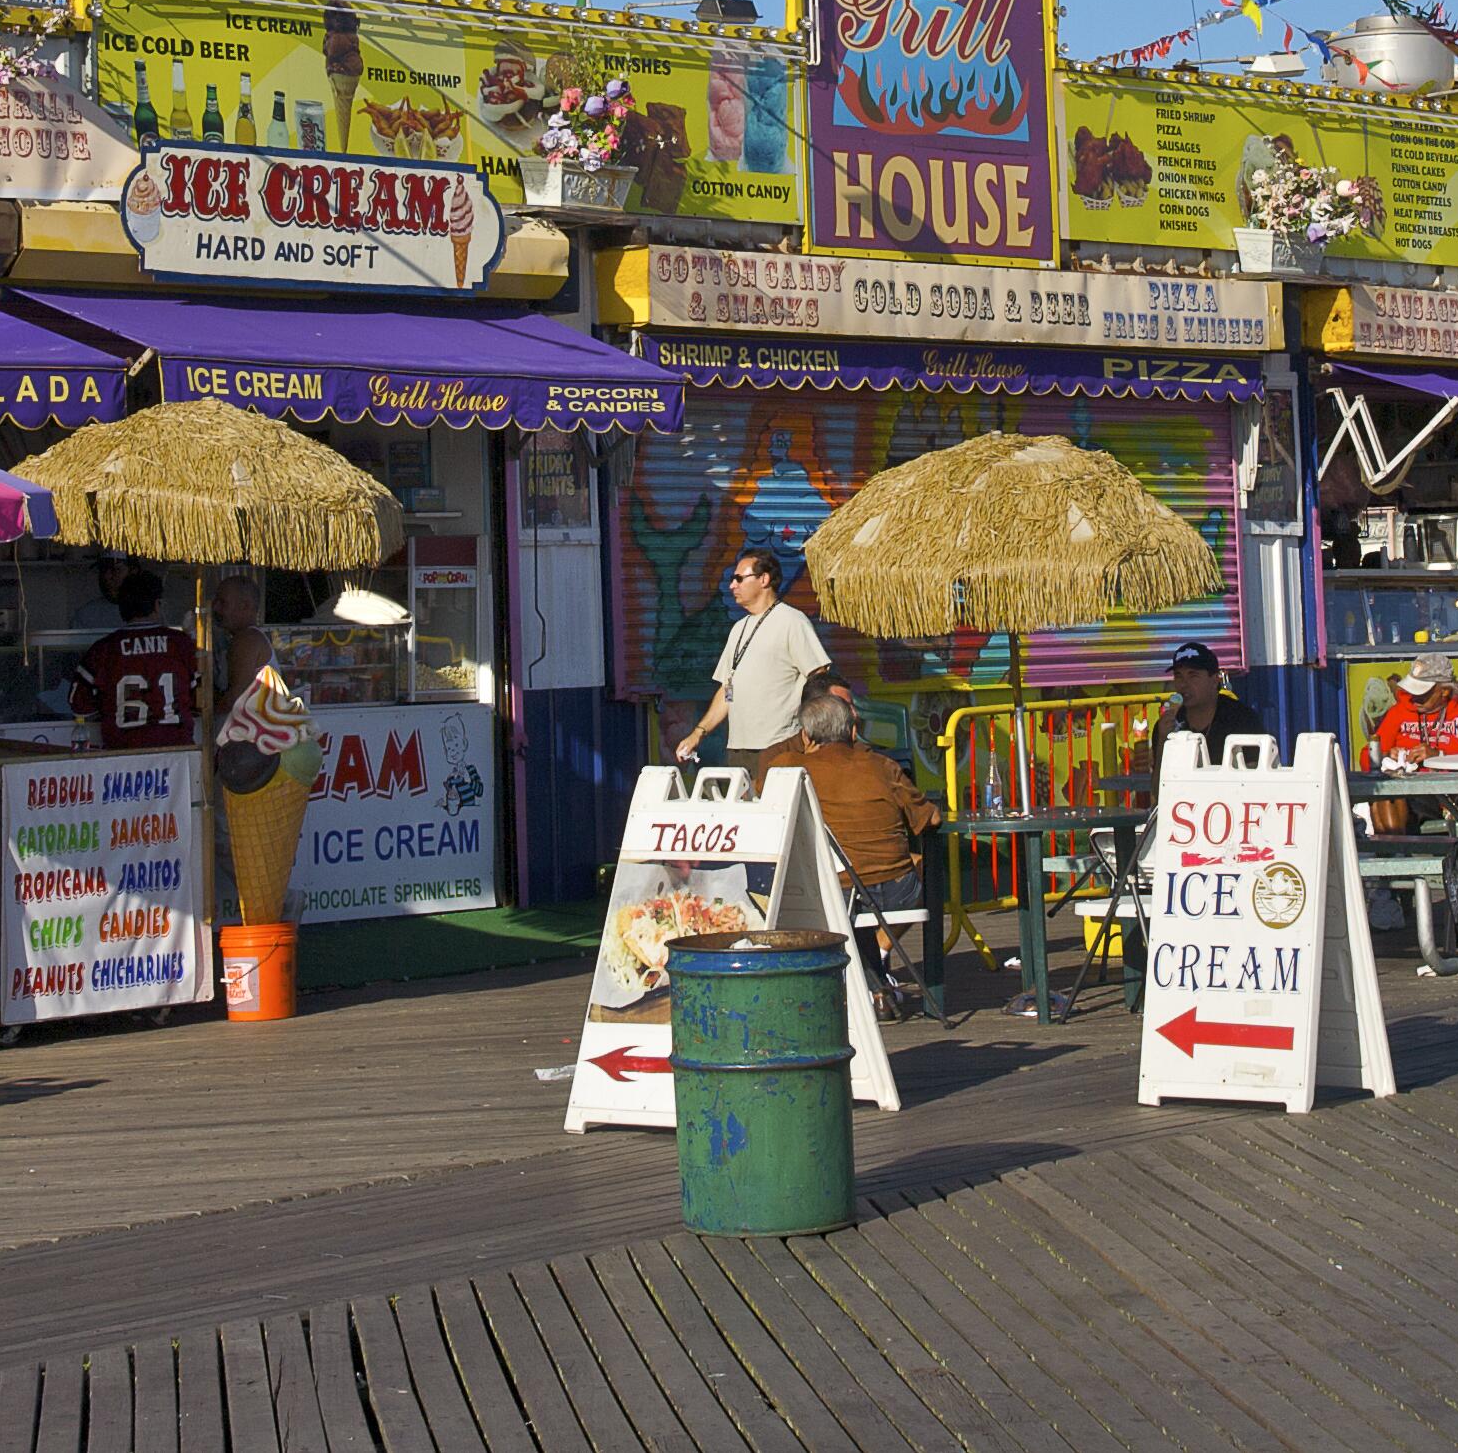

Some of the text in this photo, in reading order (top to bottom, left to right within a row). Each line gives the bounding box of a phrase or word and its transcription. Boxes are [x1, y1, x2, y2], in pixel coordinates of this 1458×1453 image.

[226, 13, 313, 37] ICE CREAM
[103, 32, 251, 62] ICE COLD BEER
[366, 66, 462, 89] FRIED SHRIMP
[1156, 109, 1215, 123] FRIED SHRIMP
[1156, 124, 1182, 136] PIZZA
[1157, 140, 1201, 153] SAUSAGES
[1391, 148, 1403, 158] ICE
[1404, 149, 1424, 160] COLD
[1157, 156, 1217, 171] FRENCH FRIES
[691, 177, 792, 205] COTTON CANDY
[1158, 172, 1214, 186] ONION RINGS
[161, 153, 451, 237] ICE CREAM
[832, 150, 1037, 248] HOUSE
[1159, 188, 1225, 203] CHICKEN WINGS
[1159, 205, 1210, 217] CORN DOGS
[1160, 220, 1198, 232] KNISHES
[196, 233, 379, 269] HARD AND SOFT
[853, 278, 1091, 327] COLD SODA & BEER
[659, 342, 839, 372] SHRIMP & CHICKEN
[1102, 357, 1248, 385] PIZZA
[186, 366, 322, 399] ICE CREAM
[368, 373, 509, 412] Grill House
[547, 386, 660, 403] POPCORN
[545, 398, 666, 415] & CANDIES
[120, 635, 168, 656] CANN
[115, 673, 180, 730] 61
[28, 767, 169, 810] REDBULL SNAPPLE
[17, 813, 179, 861] GATORADE SANGRIA
[650, 823, 740, 852] TACOS
[1167, 801, 1310, 848] SOFT
[314, 819, 480, 865] ICE CREAM
[14, 858, 181, 905] TROPICANA JARITOS
[393, 878, 482, 904] SPRINKLERS
[1163, 871, 1244, 920] ICE
[30, 906, 172, 952] CHIPS CANDIES
[11, 962, 84, 1000] PEANUTS
[91, 951, 185, 990] CHICHARINES
[1153, 942, 1302, 995] CREAM
